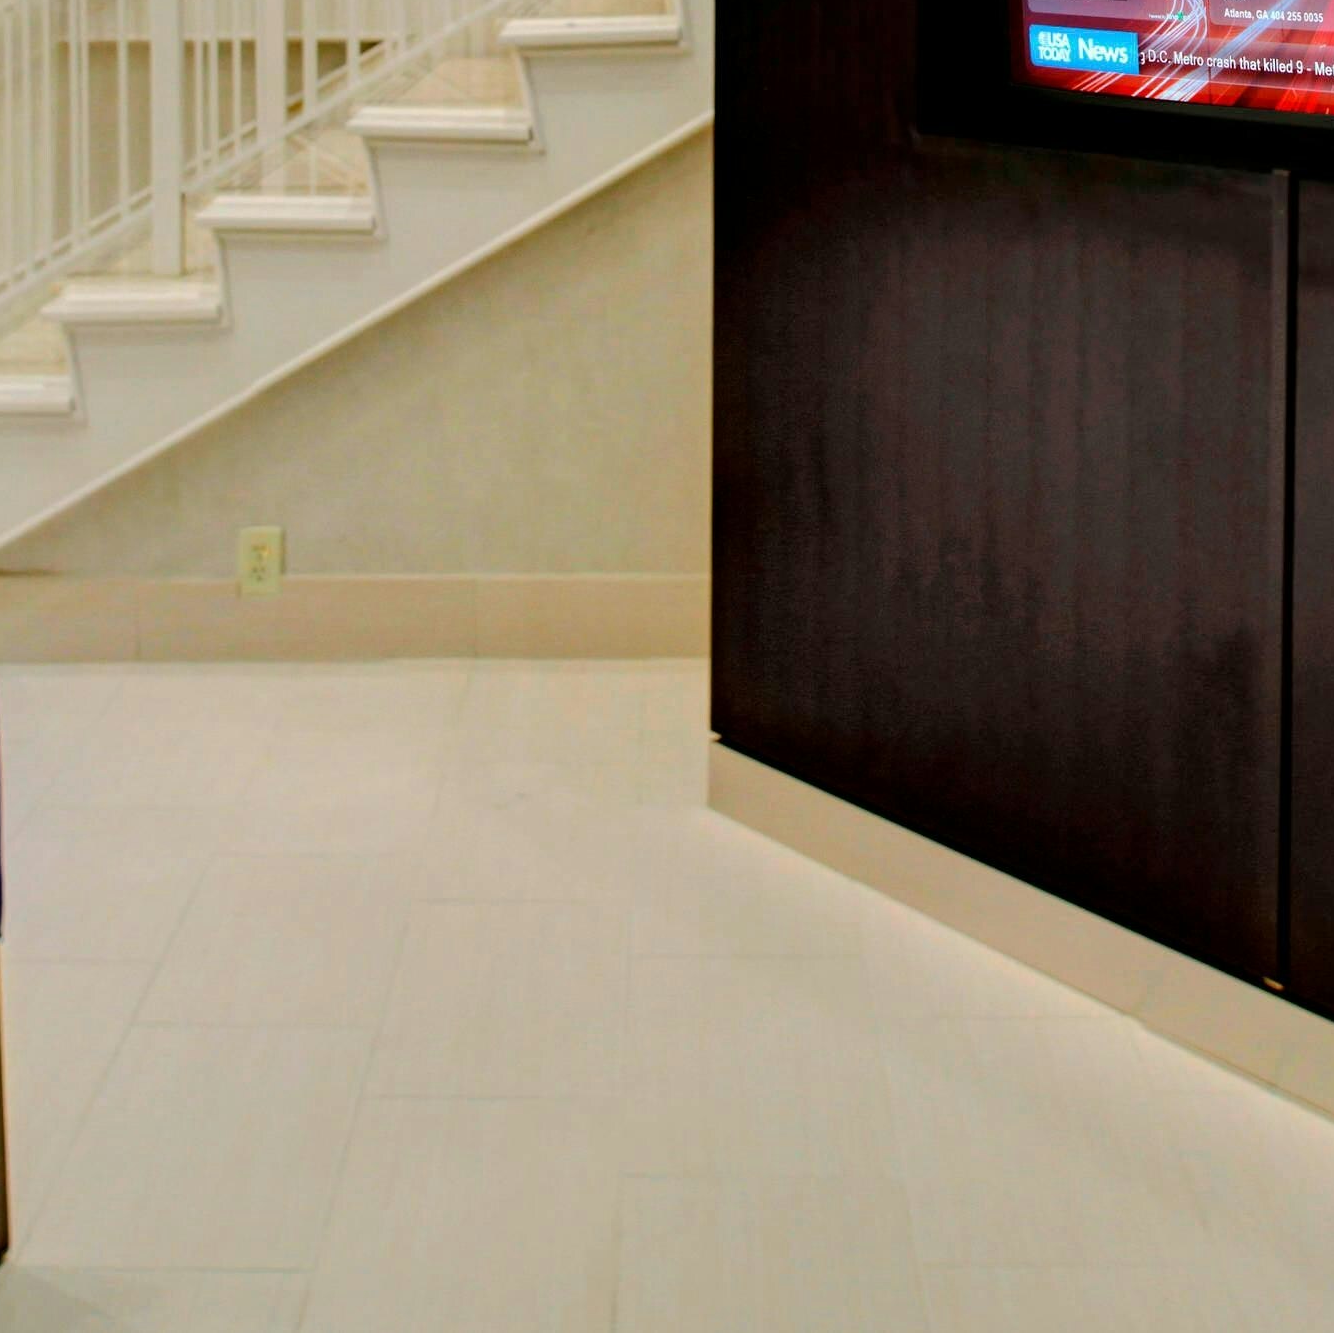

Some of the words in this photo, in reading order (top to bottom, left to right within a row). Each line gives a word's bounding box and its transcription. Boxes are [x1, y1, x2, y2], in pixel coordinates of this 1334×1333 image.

[1224, 9, 1254, 20] Atlanta,
[1256, 10, 1267, 20] GA
[1270, 11, 1285, 21] 404
[1287, 11, 1302, 21] 255
[1304, 12, 1323, 23] 0035
[1038, 46, 1072, 62] TODAY
[1078, 38, 1128, 64] News
[1149, 50, 1171, 64] D.C.
[1174, 52, 1203, 66] Metro
[1206, 56, 1236, 69] crash
[1239, 57, 1261, 71] that
[1264, 58, 1293, 73] killed
[1296, 61, 1304, 74] 9
